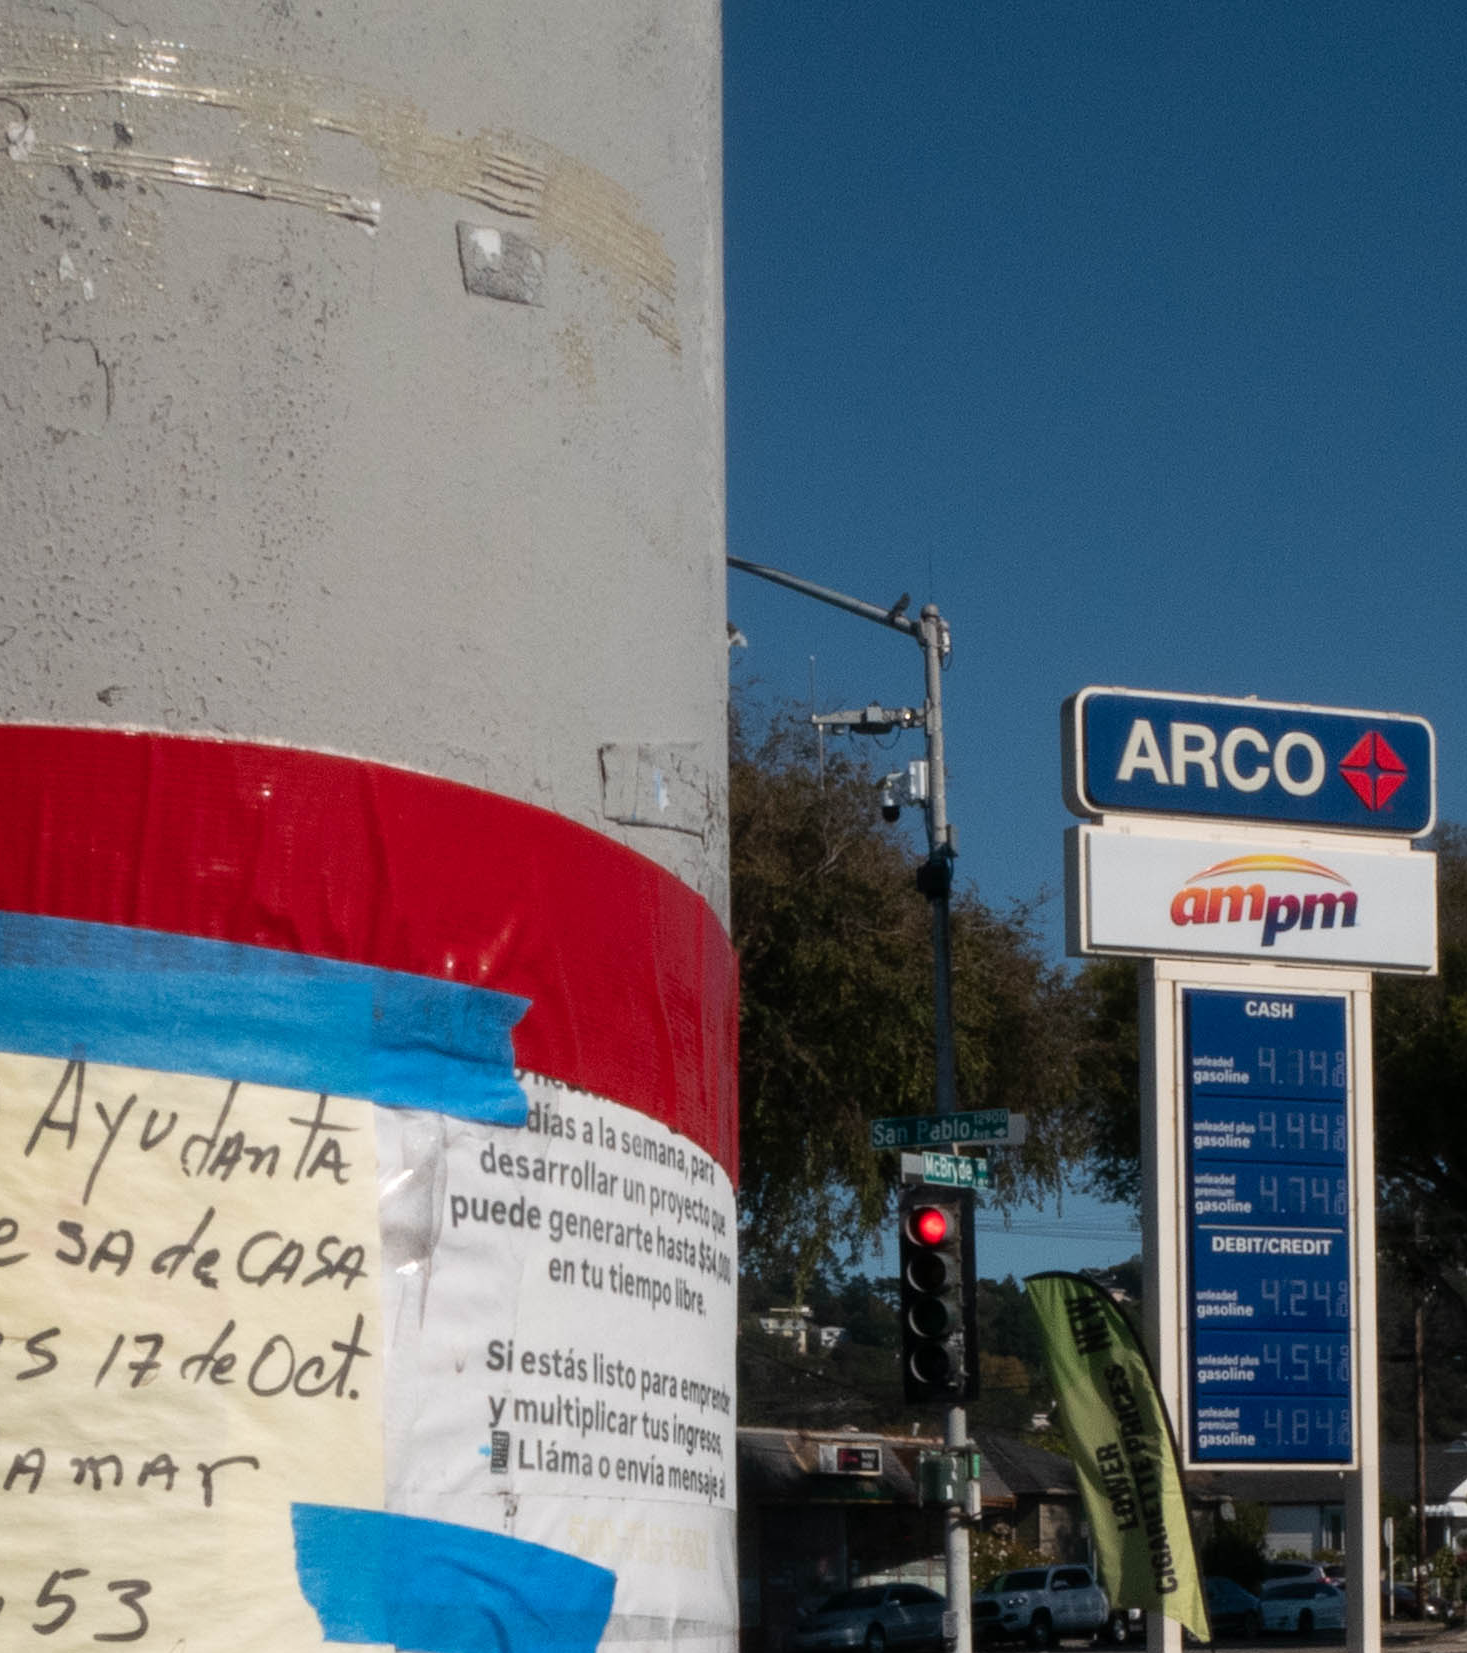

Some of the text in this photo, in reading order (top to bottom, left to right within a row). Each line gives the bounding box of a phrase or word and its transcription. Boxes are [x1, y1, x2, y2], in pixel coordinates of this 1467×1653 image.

[1116, 719, 1326, 797] ARCO
[1170, 883, 1359, 947] ampm
[1245, 1000, 1294, 1019] CASH
[1193, 1056, 1234, 1067] unleaded
[1193, 1069, 1251, 1085] gasoline
[873, 1118, 970, 1145] San Pablo
[1194, 1121, 1235, 1132] unleaded
[1236, 1122, 1256, 1135] plus
[527, 1102, 577, 1141] días
[582, 1120, 594, 1146] a
[598, 1116, 617, 1150] la
[621, 1131, 689, 1178] semana,
[1195, 1134, 1251, 1150] gasoline
[925, 1155, 973, 1185] McBryde
[1195, 1174, 1236, 1185] unleaded
[481, 1142, 619, 1197] desarrollar
[623, 1177, 646, 1206] un
[650, 1185, 710, 1229] proyecto
[1195, 1187, 1236, 1199] premium
[1195, 1199, 1252, 1216] gasoline
[450, 1194, 542, 1229] puede
[548, 1208, 654, 1255] generarte
[656, 1225, 696, 1268] hasta
[1212, 1237, 1333, 1256] DEBIT/CREDIT
[548, 1256, 576, 1285] en
[580, 1258, 604, 1290] tu
[608, 1262, 672, 1311] tiempo
[1197, 1290, 1238, 1301] unleaded
[1197, 1303, 1255, 1319] gasoline
[94, 1331, 165, 1387] 17
[180, 1318, 236, 1383] de
[1197, 1354, 1239, 1365] unleaded
[1240, 1355, 1260, 1368] plus
[485, 1339, 514, 1373] Si
[520, 1348, 588, 1383] estás
[592, 1352, 637, 1390] listo
[640, 1367, 678, 1402] para
[1197, 1367, 1256, 1383] gasoline
[488, 1395, 508, 1429] y
[514, 1393, 638, 1439] multiplicar
[641, 1412, 669, 1444] tus
[1198, 1408, 1240, 1419] unleaded
[1198, 1420, 1239, 1432] premium
[1199, 1432, 1256, 1449] gasoline
[598, 1455, 611, 1479] o
[1095, 1442, 1138, 1532] LOWER
[1131, 1454, 1180, 1595] CIGARETTE
